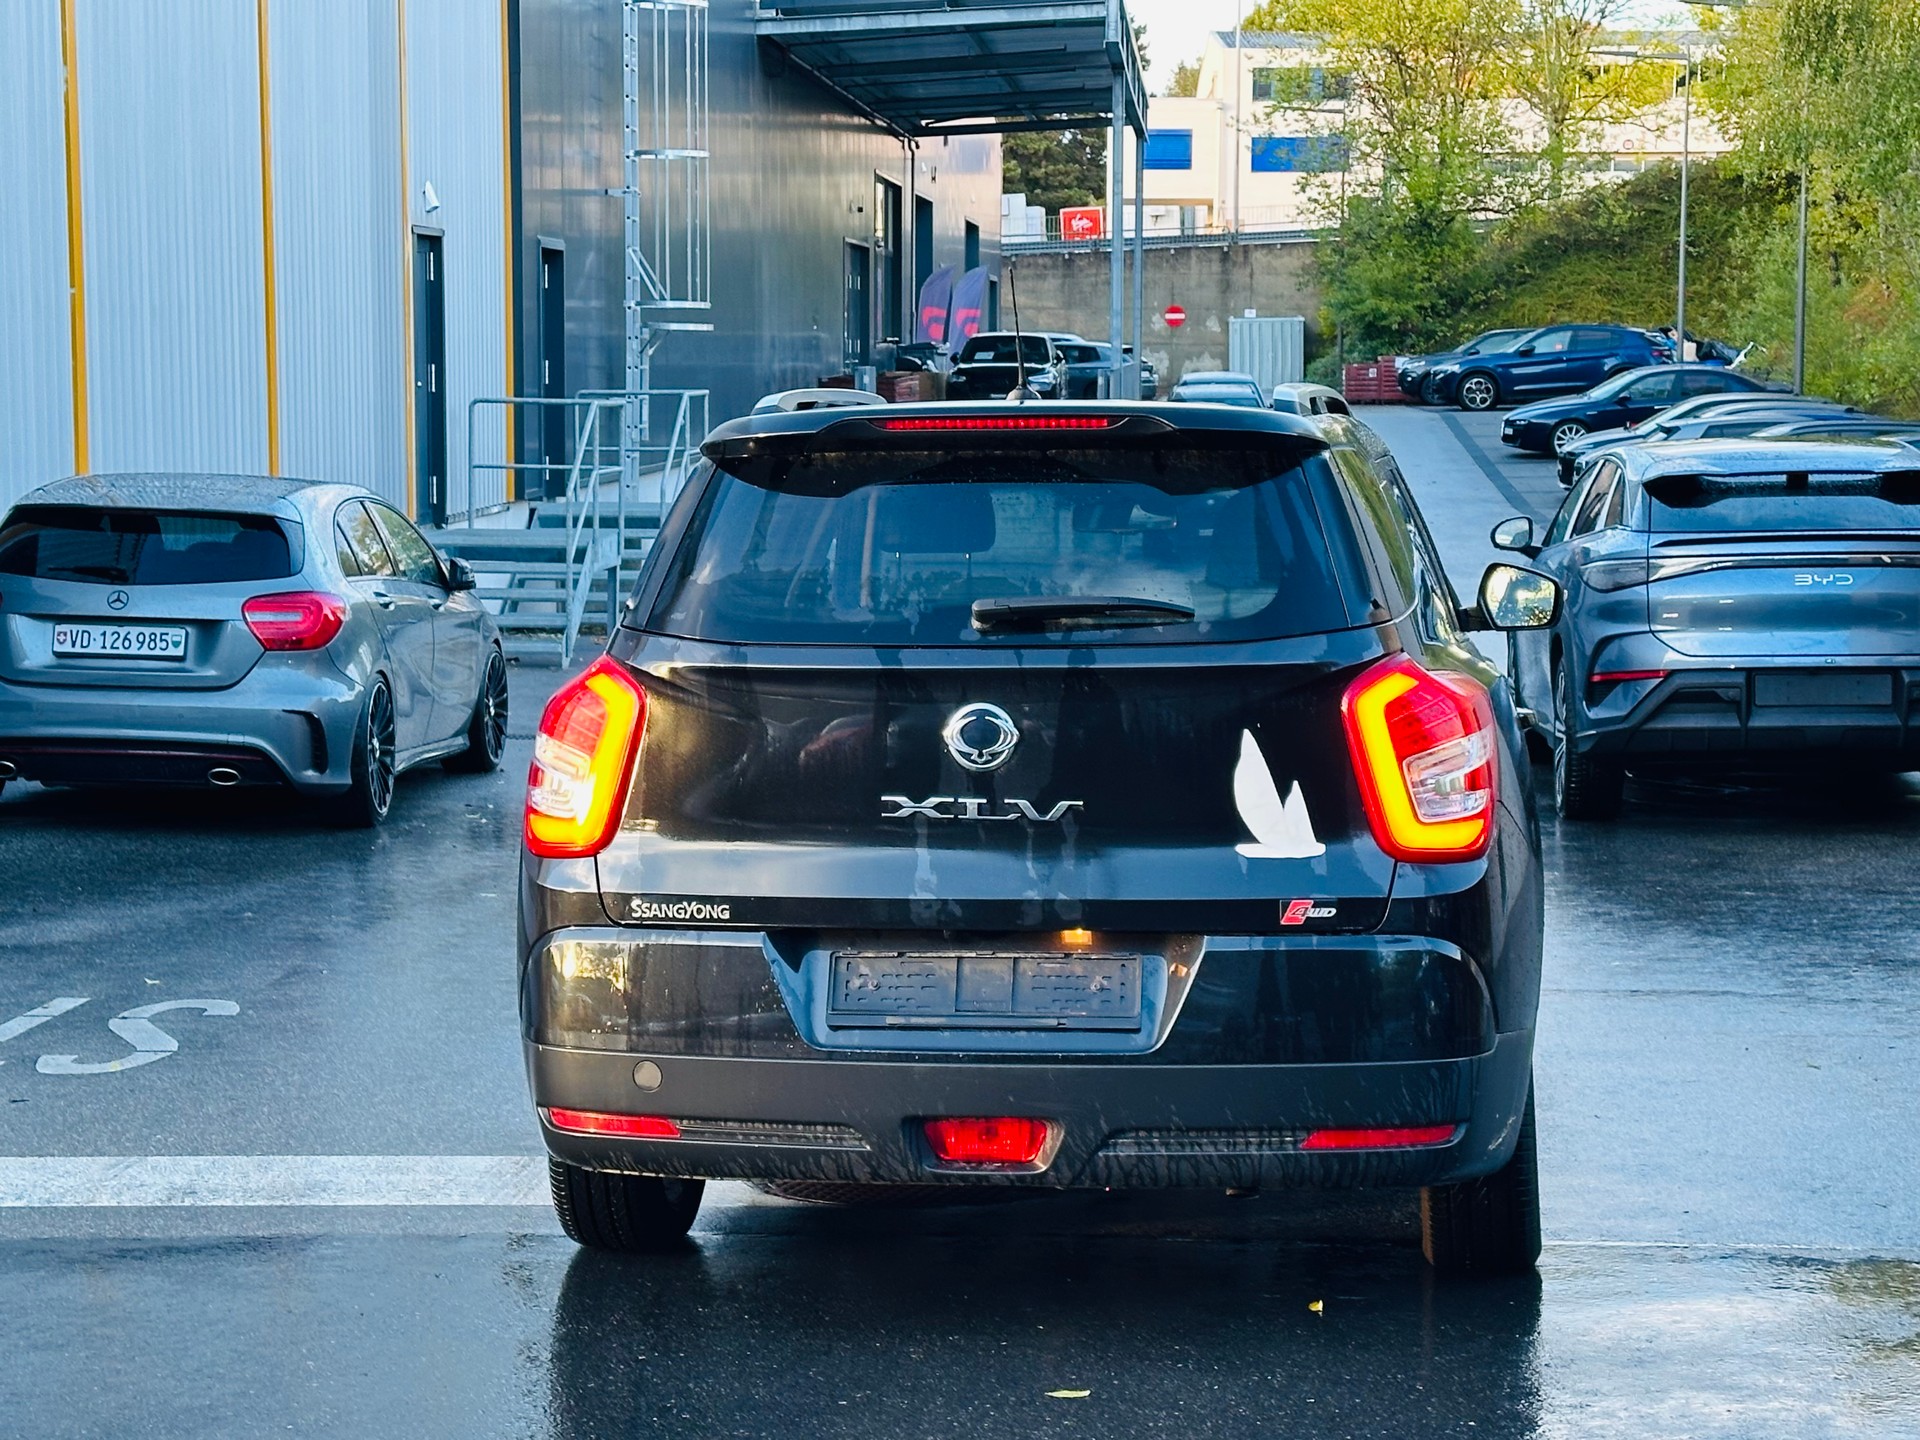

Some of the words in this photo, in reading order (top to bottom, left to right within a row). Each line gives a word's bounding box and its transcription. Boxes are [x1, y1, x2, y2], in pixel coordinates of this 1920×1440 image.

[1794, 574, 1854, 586] BYD
[881, 796, 1084, 821] XLV
[1285, 903, 1337, 919] 4WD
